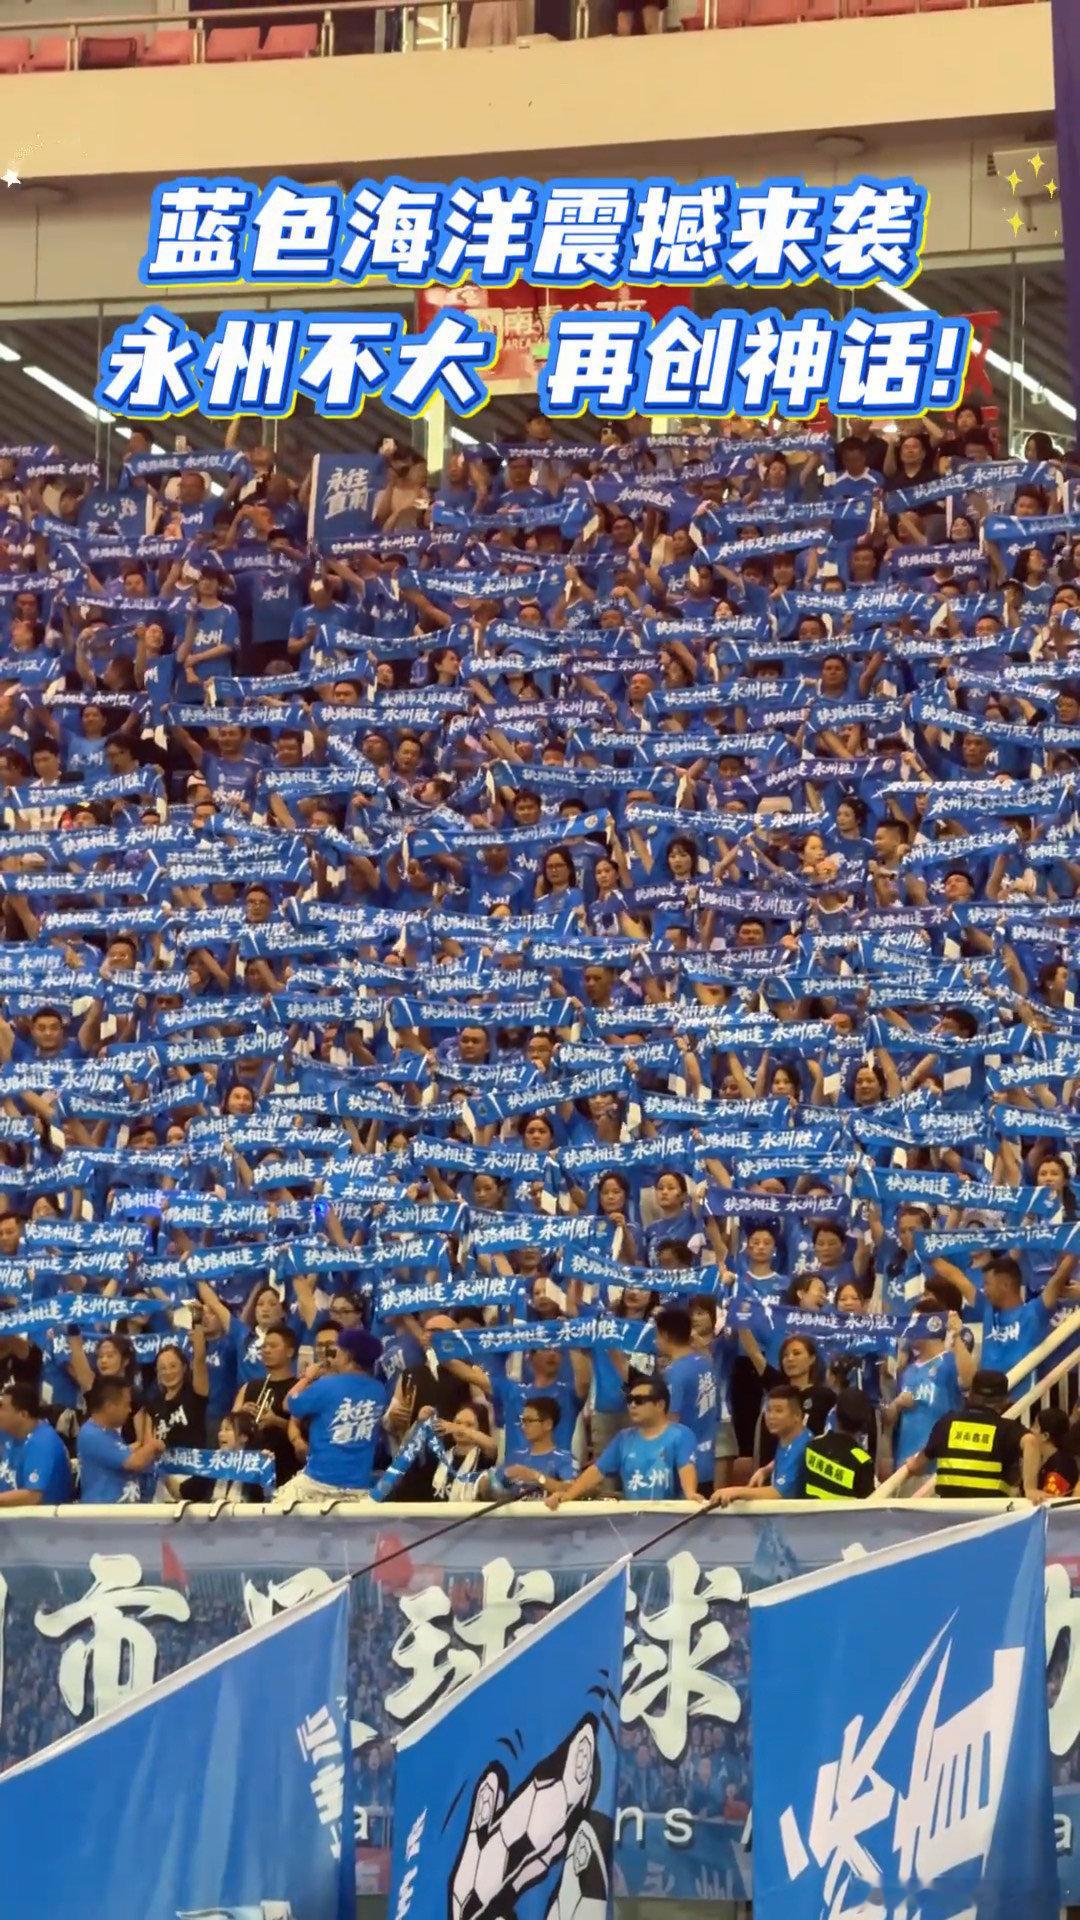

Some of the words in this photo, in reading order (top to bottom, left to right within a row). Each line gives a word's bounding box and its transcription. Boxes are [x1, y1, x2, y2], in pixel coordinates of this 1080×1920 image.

[453, 1276, 516, 1299] 永州胜!
[629, 1467, 669, 1491] 永州
